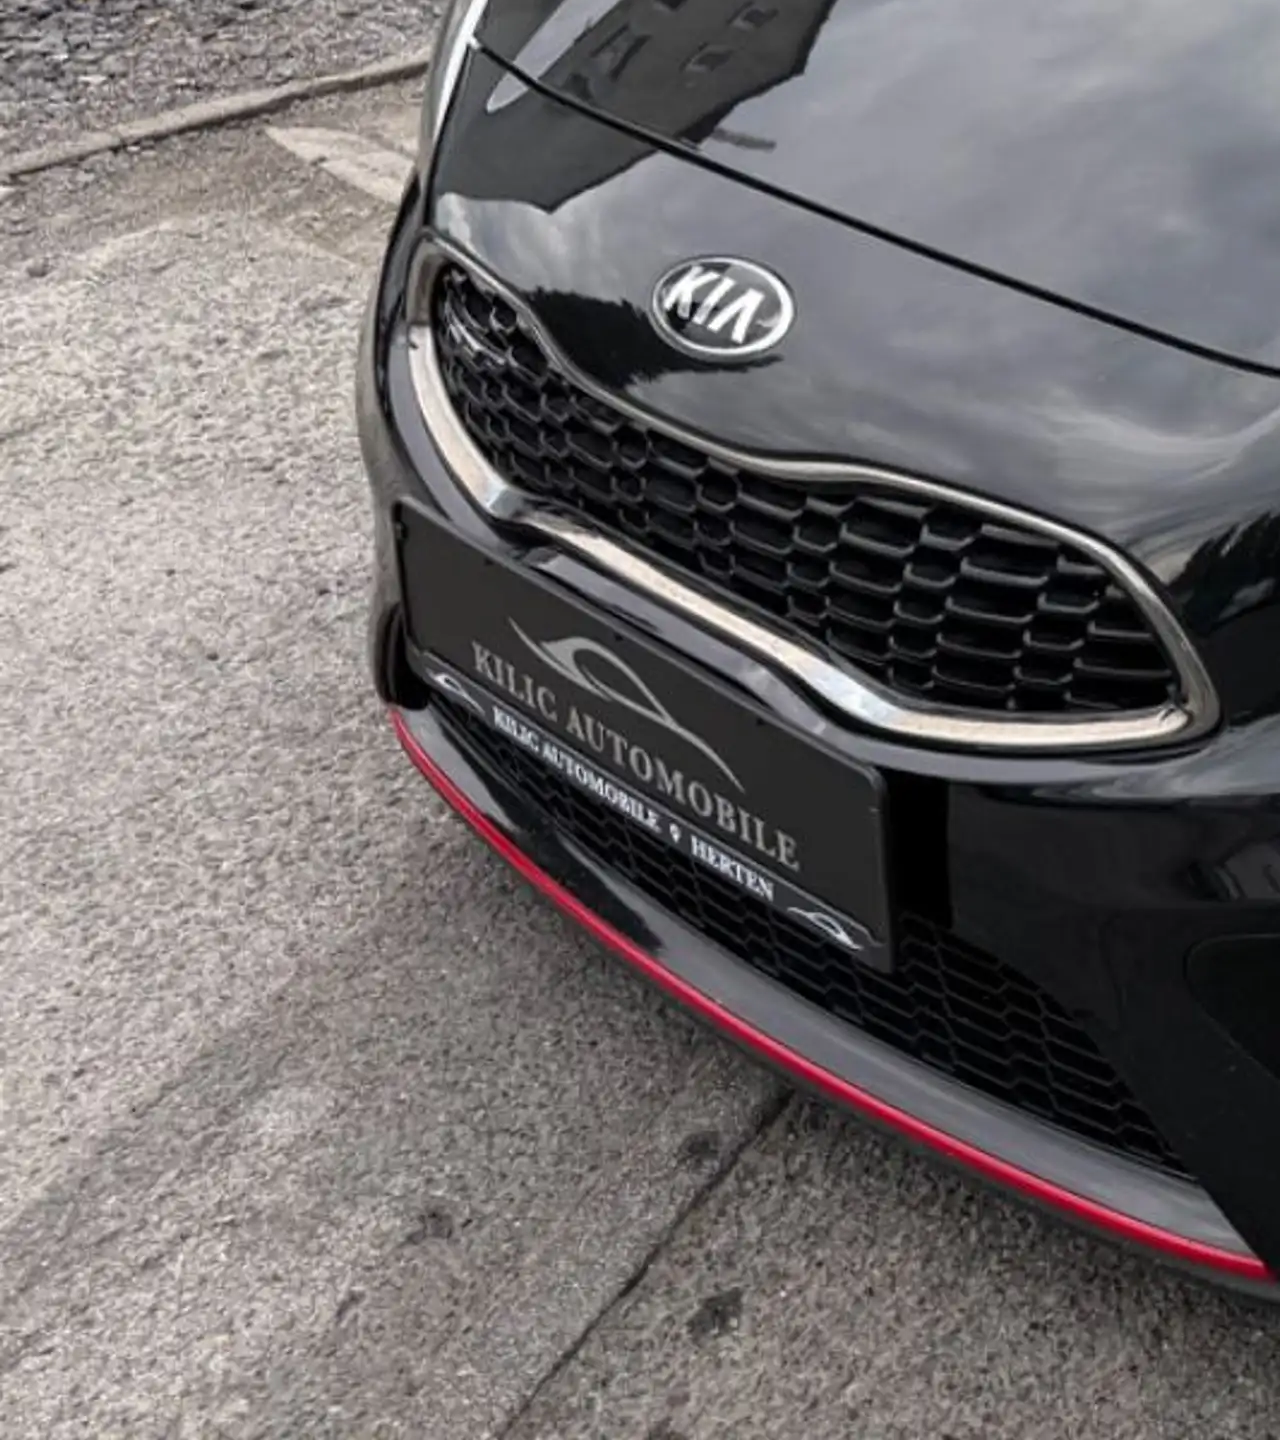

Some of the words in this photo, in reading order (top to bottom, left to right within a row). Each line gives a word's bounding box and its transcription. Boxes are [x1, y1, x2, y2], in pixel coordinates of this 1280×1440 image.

[664, 265, 764, 344] KIA
[471, 640, 557, 722] KILIC
[566, 706, 799, 872] AUTOMOBILE
[492, 705, 539, 753] KILIC
[542, 742, 661, 834] AUTOMOBILE
[690, 834, 774, 903] HERTEN
